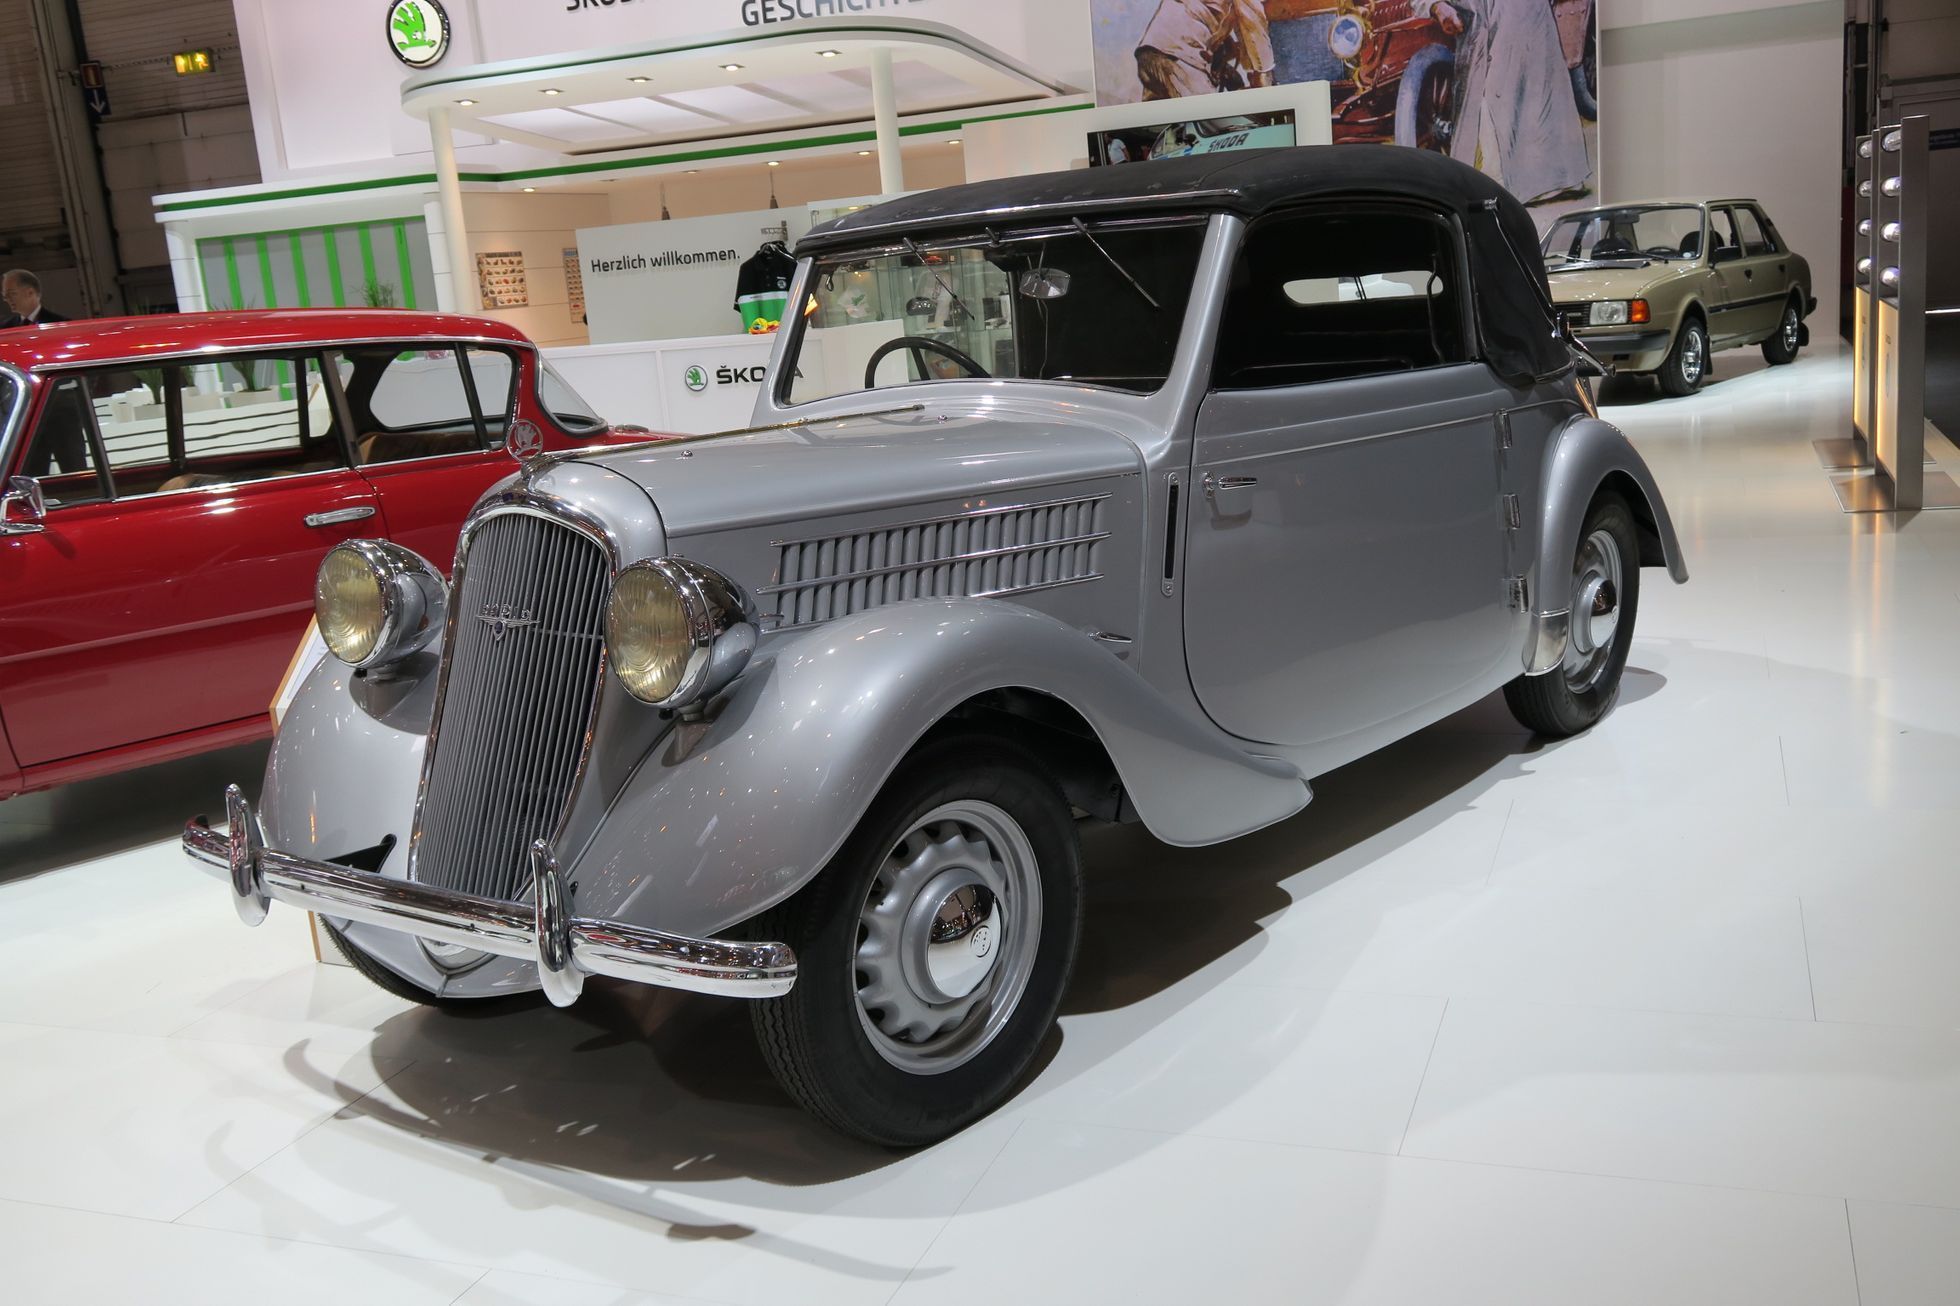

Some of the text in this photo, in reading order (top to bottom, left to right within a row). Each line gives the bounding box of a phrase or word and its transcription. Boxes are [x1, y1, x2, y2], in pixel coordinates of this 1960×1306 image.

[741, 0, 925, 26] GESCHI
[591, 249, 741, 273] Herzlich willkommen.
[716, 365, 804, 385] ŠKOA
